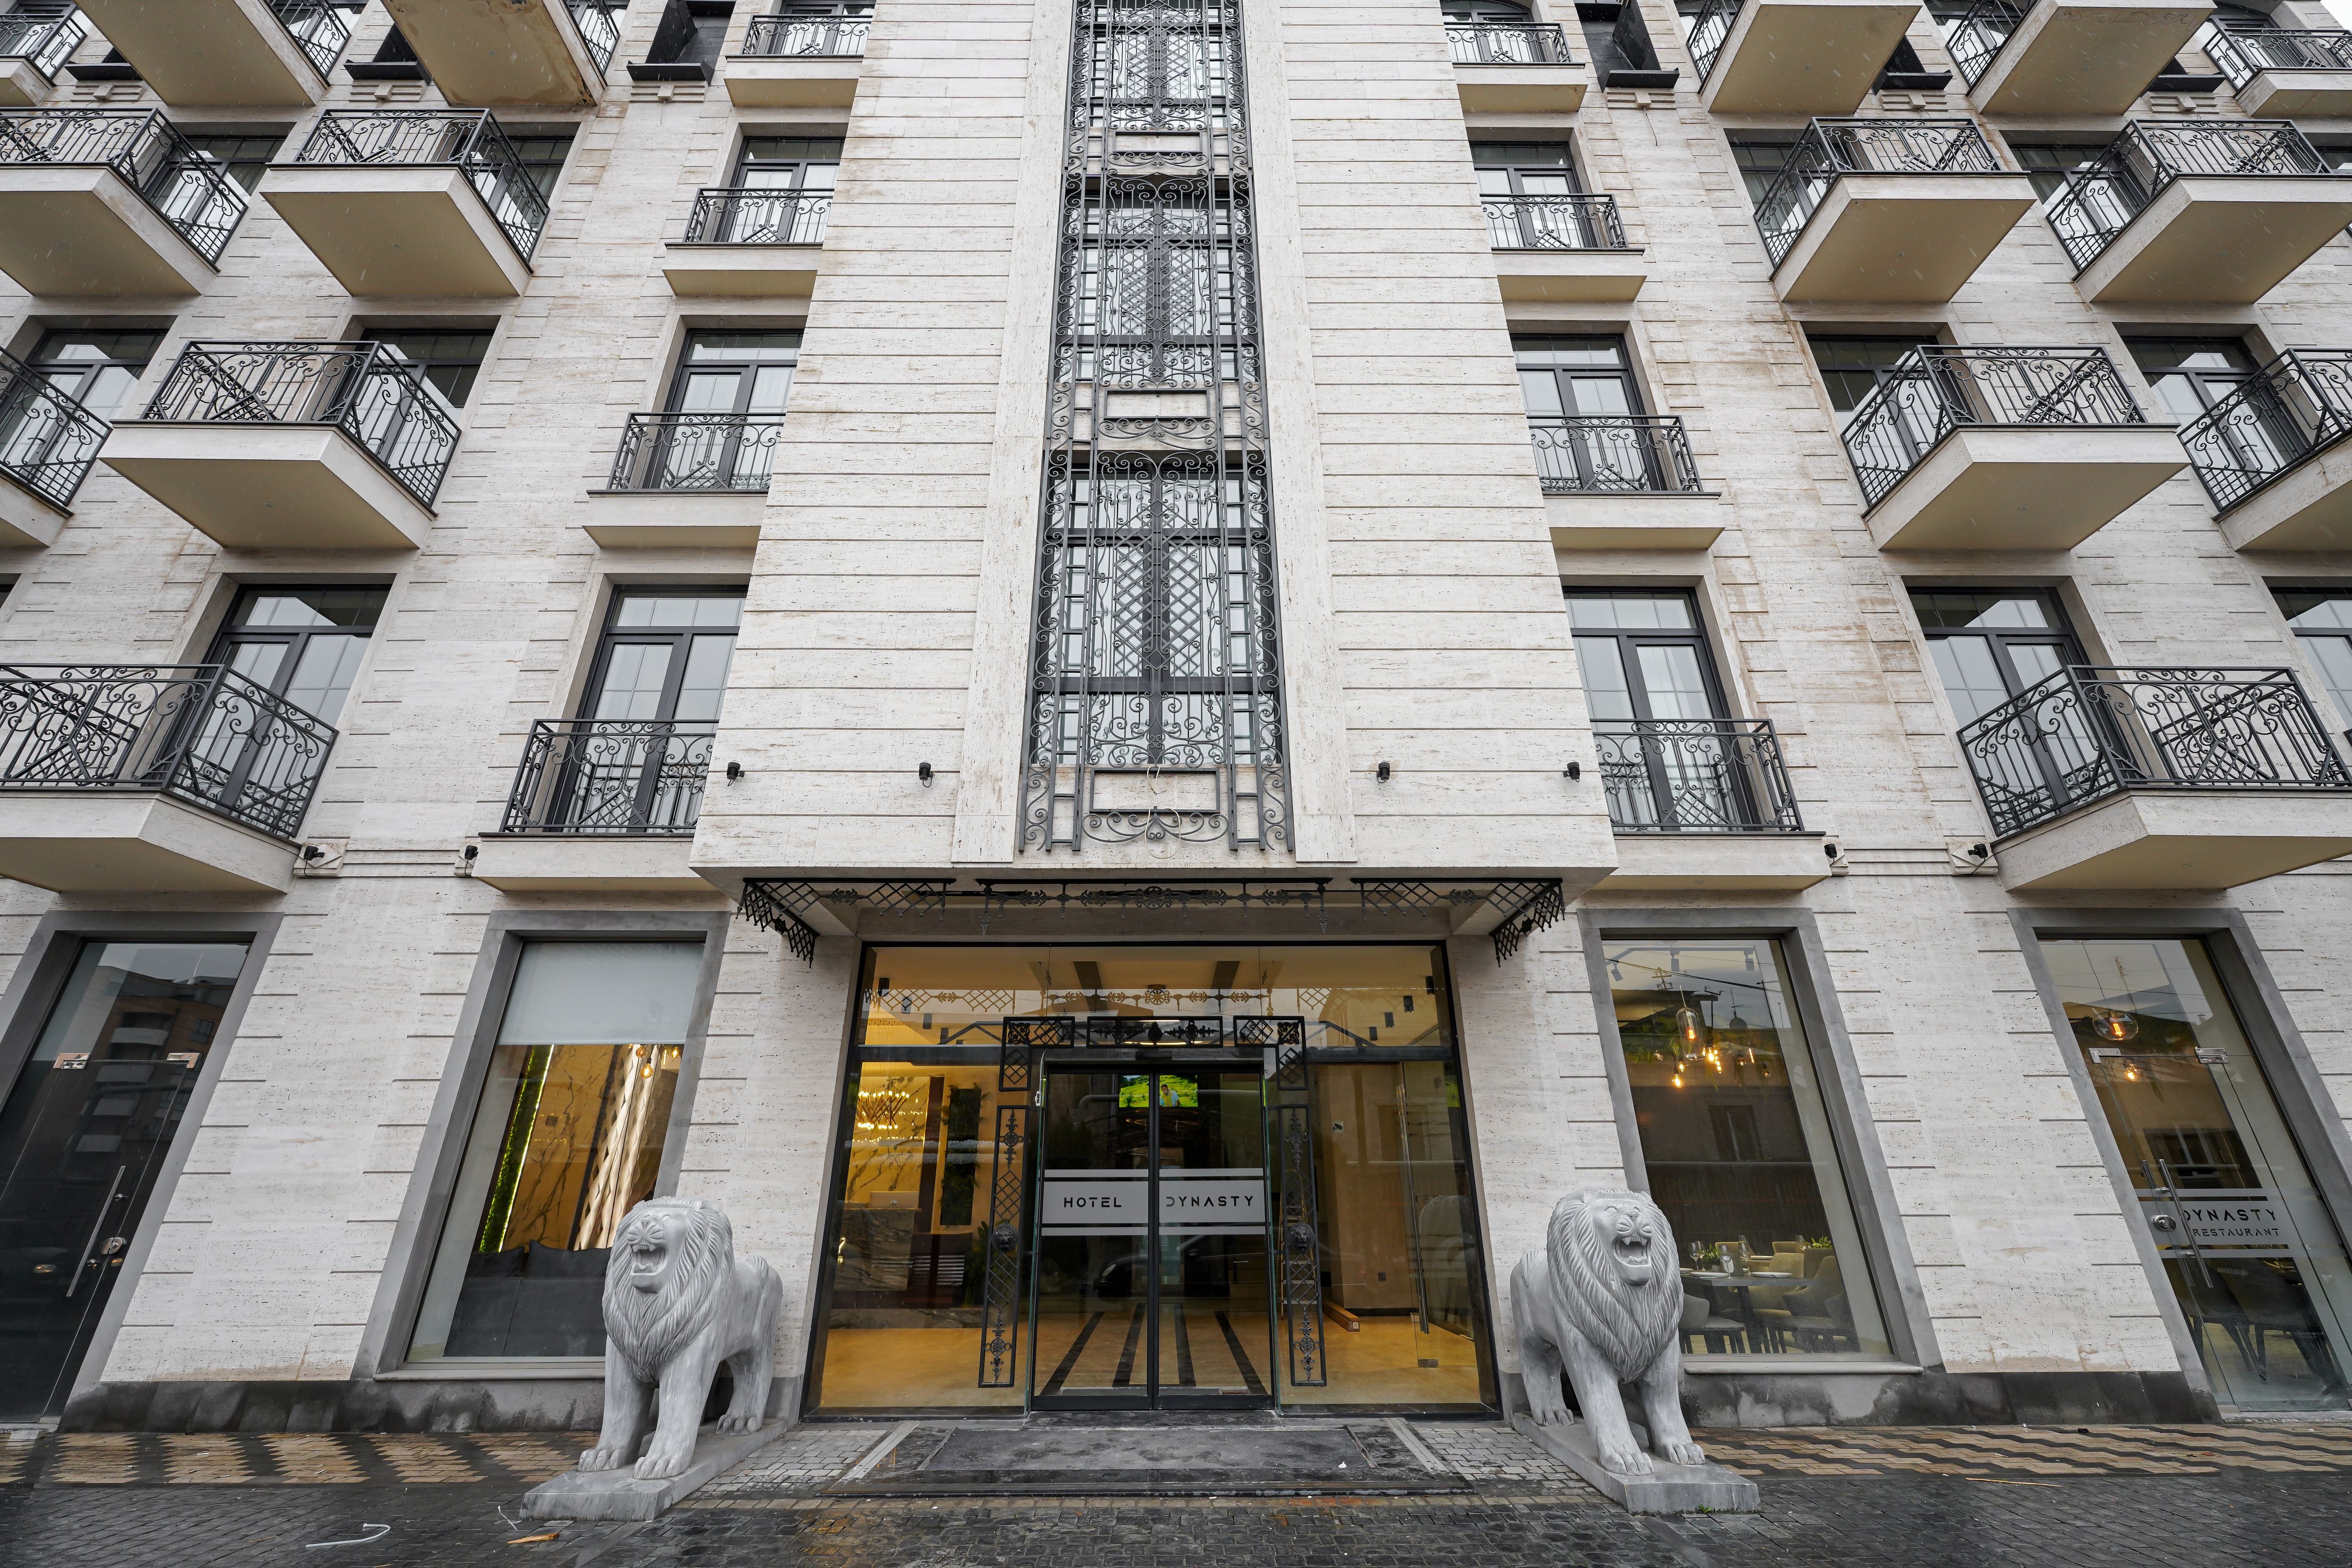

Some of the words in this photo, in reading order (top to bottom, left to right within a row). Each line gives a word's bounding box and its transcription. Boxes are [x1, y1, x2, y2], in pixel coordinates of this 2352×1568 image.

[1064, 1197, 1122, 1208] HOTEL
[1166, 1196, 1254, 1207] DYNASTY
[2183, 1209, 2276, 1221] DYNASTY
[2192, 1228, 2279, 1237] RESTAURANT
